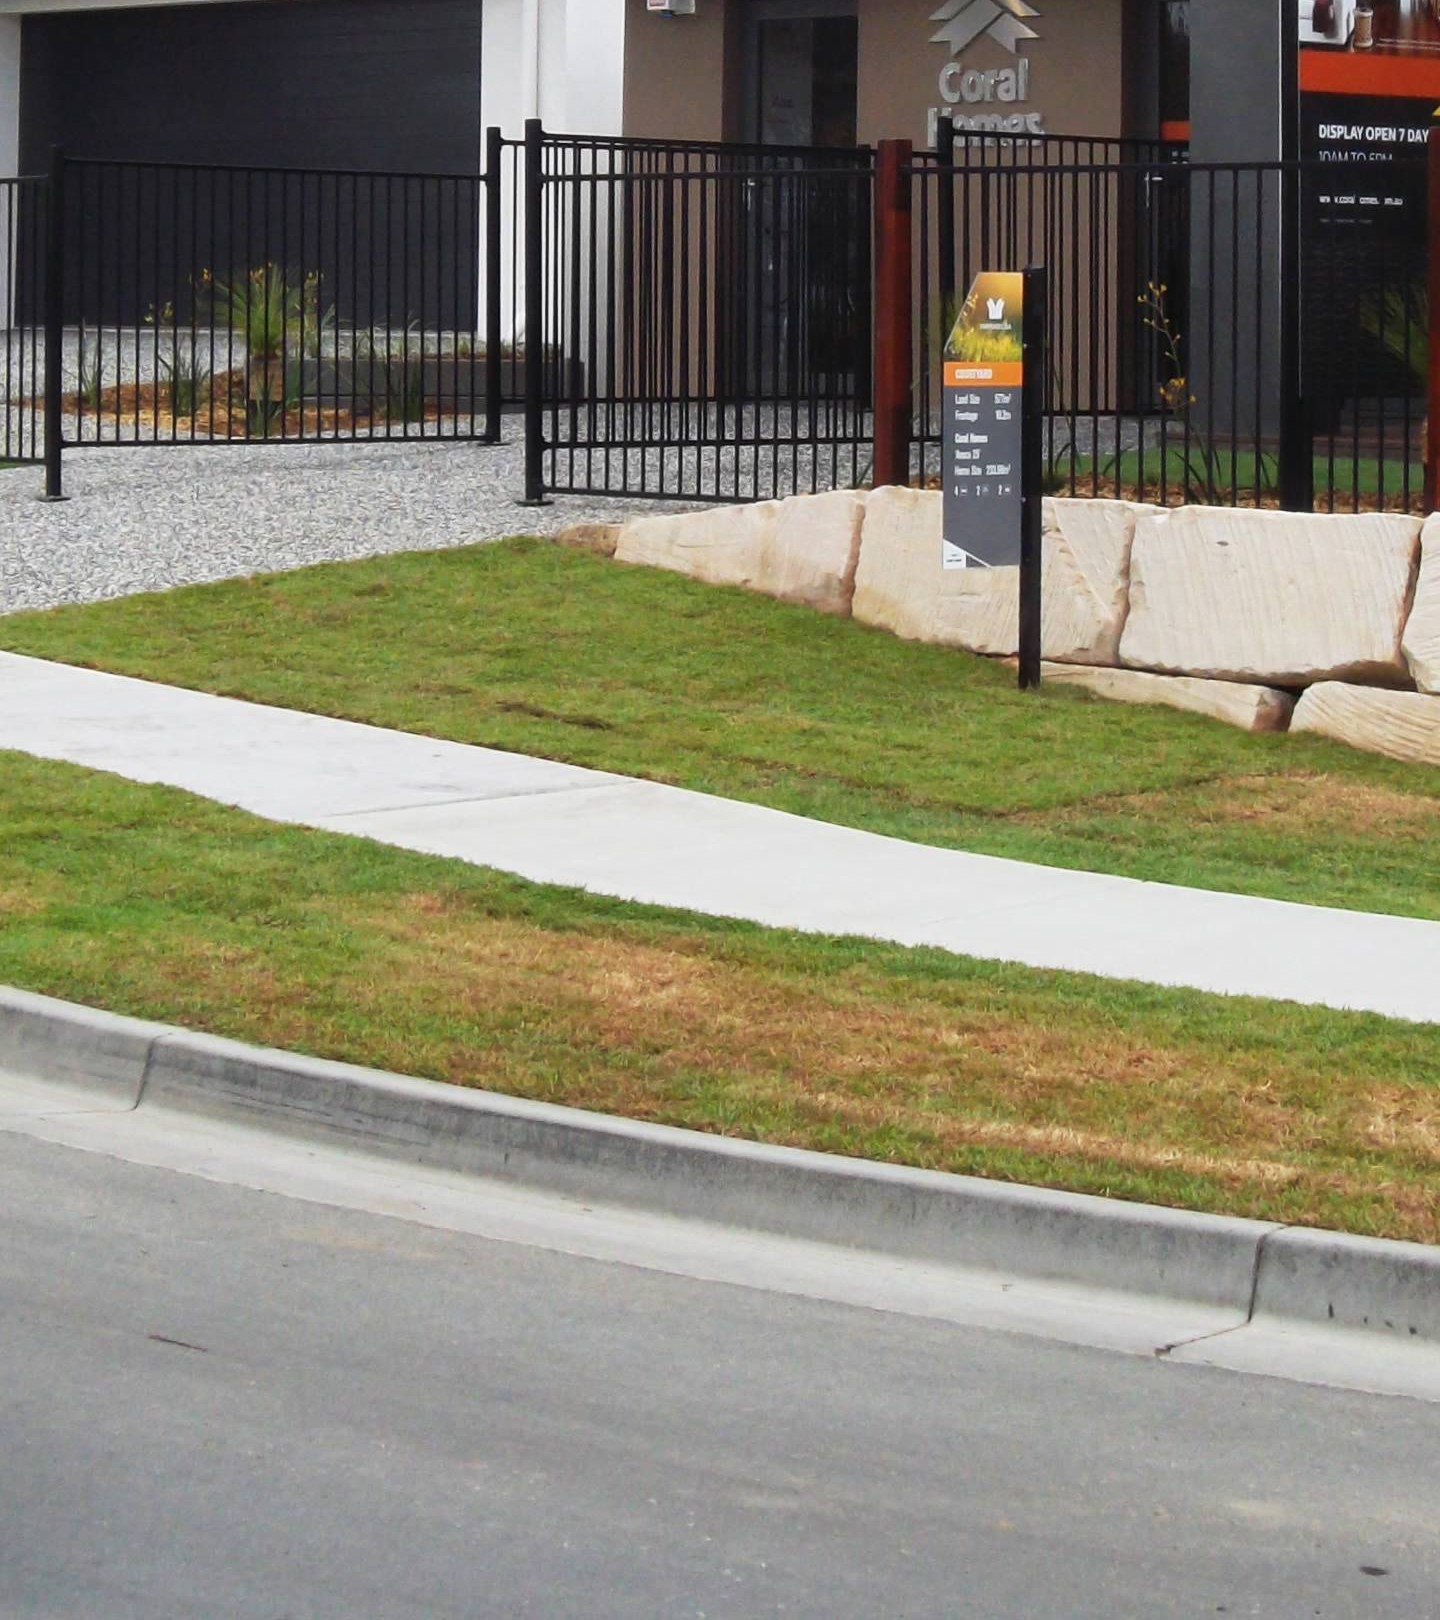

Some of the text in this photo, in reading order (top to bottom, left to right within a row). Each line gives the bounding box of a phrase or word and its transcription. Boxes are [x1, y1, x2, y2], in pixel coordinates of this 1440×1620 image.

[939, 58, 1029, 103] Coral
[1319, 124, 1429, 143] DISPLAY OPEN 7 DAY
